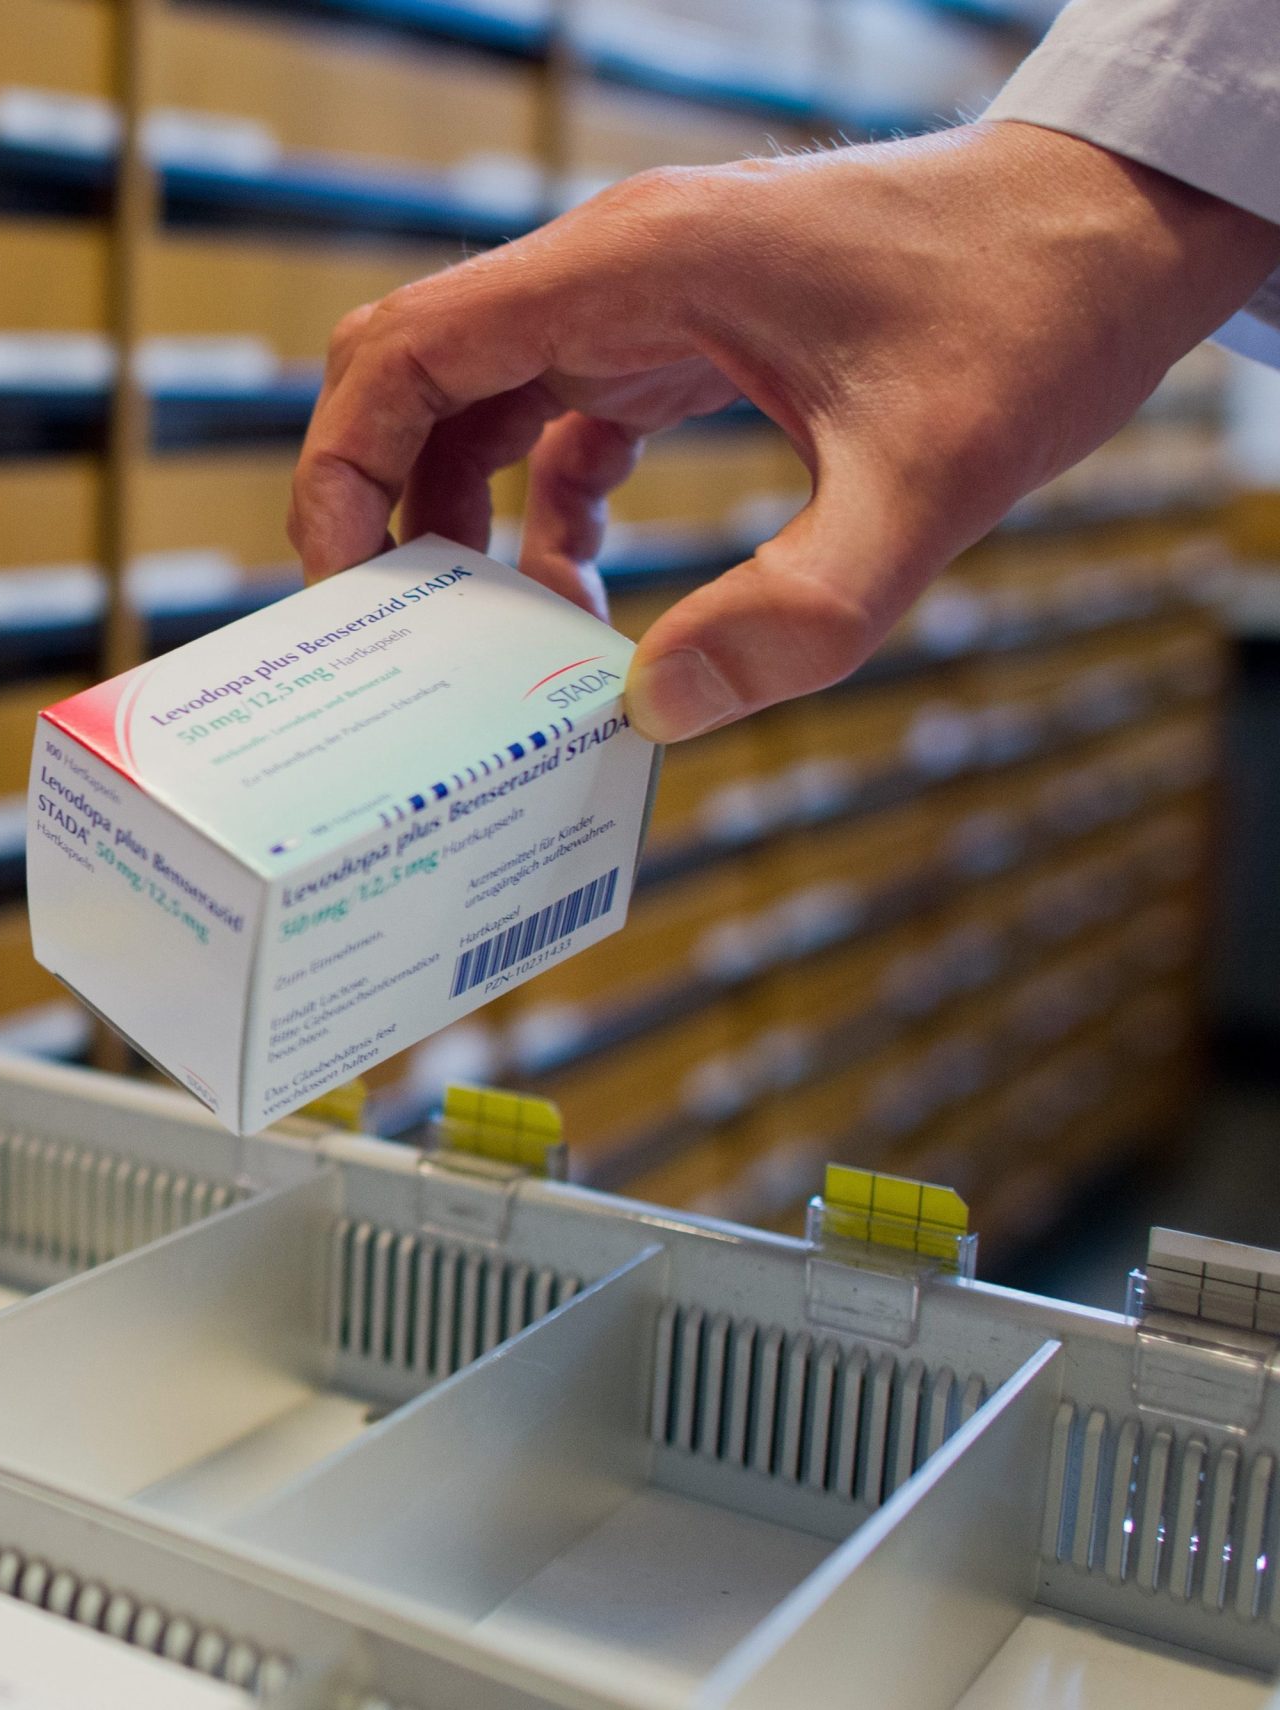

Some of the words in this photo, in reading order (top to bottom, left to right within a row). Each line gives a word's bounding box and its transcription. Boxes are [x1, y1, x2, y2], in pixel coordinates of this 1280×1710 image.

[150, 673, 255, 728] Levodopa
[254, 651, 300, 682] plus
[296, 598, 406, 656] Benserazid
[176, 724, 210, 745] 50
[293, 666, 336, 689] mg
[328, 626, 411, 670] Hartkapseln
[546, 668, 621, 709] STADA
[45, 741, 62, 761] 100
[36, 819, 95, 874] Hartkapseln
[40, 766, 111, 832] Levodopa
[115, 827, 148, 861] plus
[152, 851, 245, 934] Benserazid
[95, 840, 116, 867] 50
[282, 844, 391, 909] Levodopa
[396, 816, 442, 856] plus
[448, 746, 561, 824] Benserazid
[441, 807, 525, 858] Hartkapseln
[464, 859, 540, 909] unzugänglich
[542, 819, 616, 866] aufbewahren.
[468, 843, 537, 889] Arzneimittel
[538, 836, 556, 852] für
[558, 814, 596, 841] Kinder
[459, 905, 521, 948] Hartkapsel
[274, 968, 308, 991] Zum
[302, 953, 440, 1031] Gebrauchsinformation
[263, 1082, 290, 1102] Das
[374, 1022, 397, 1042] fest
